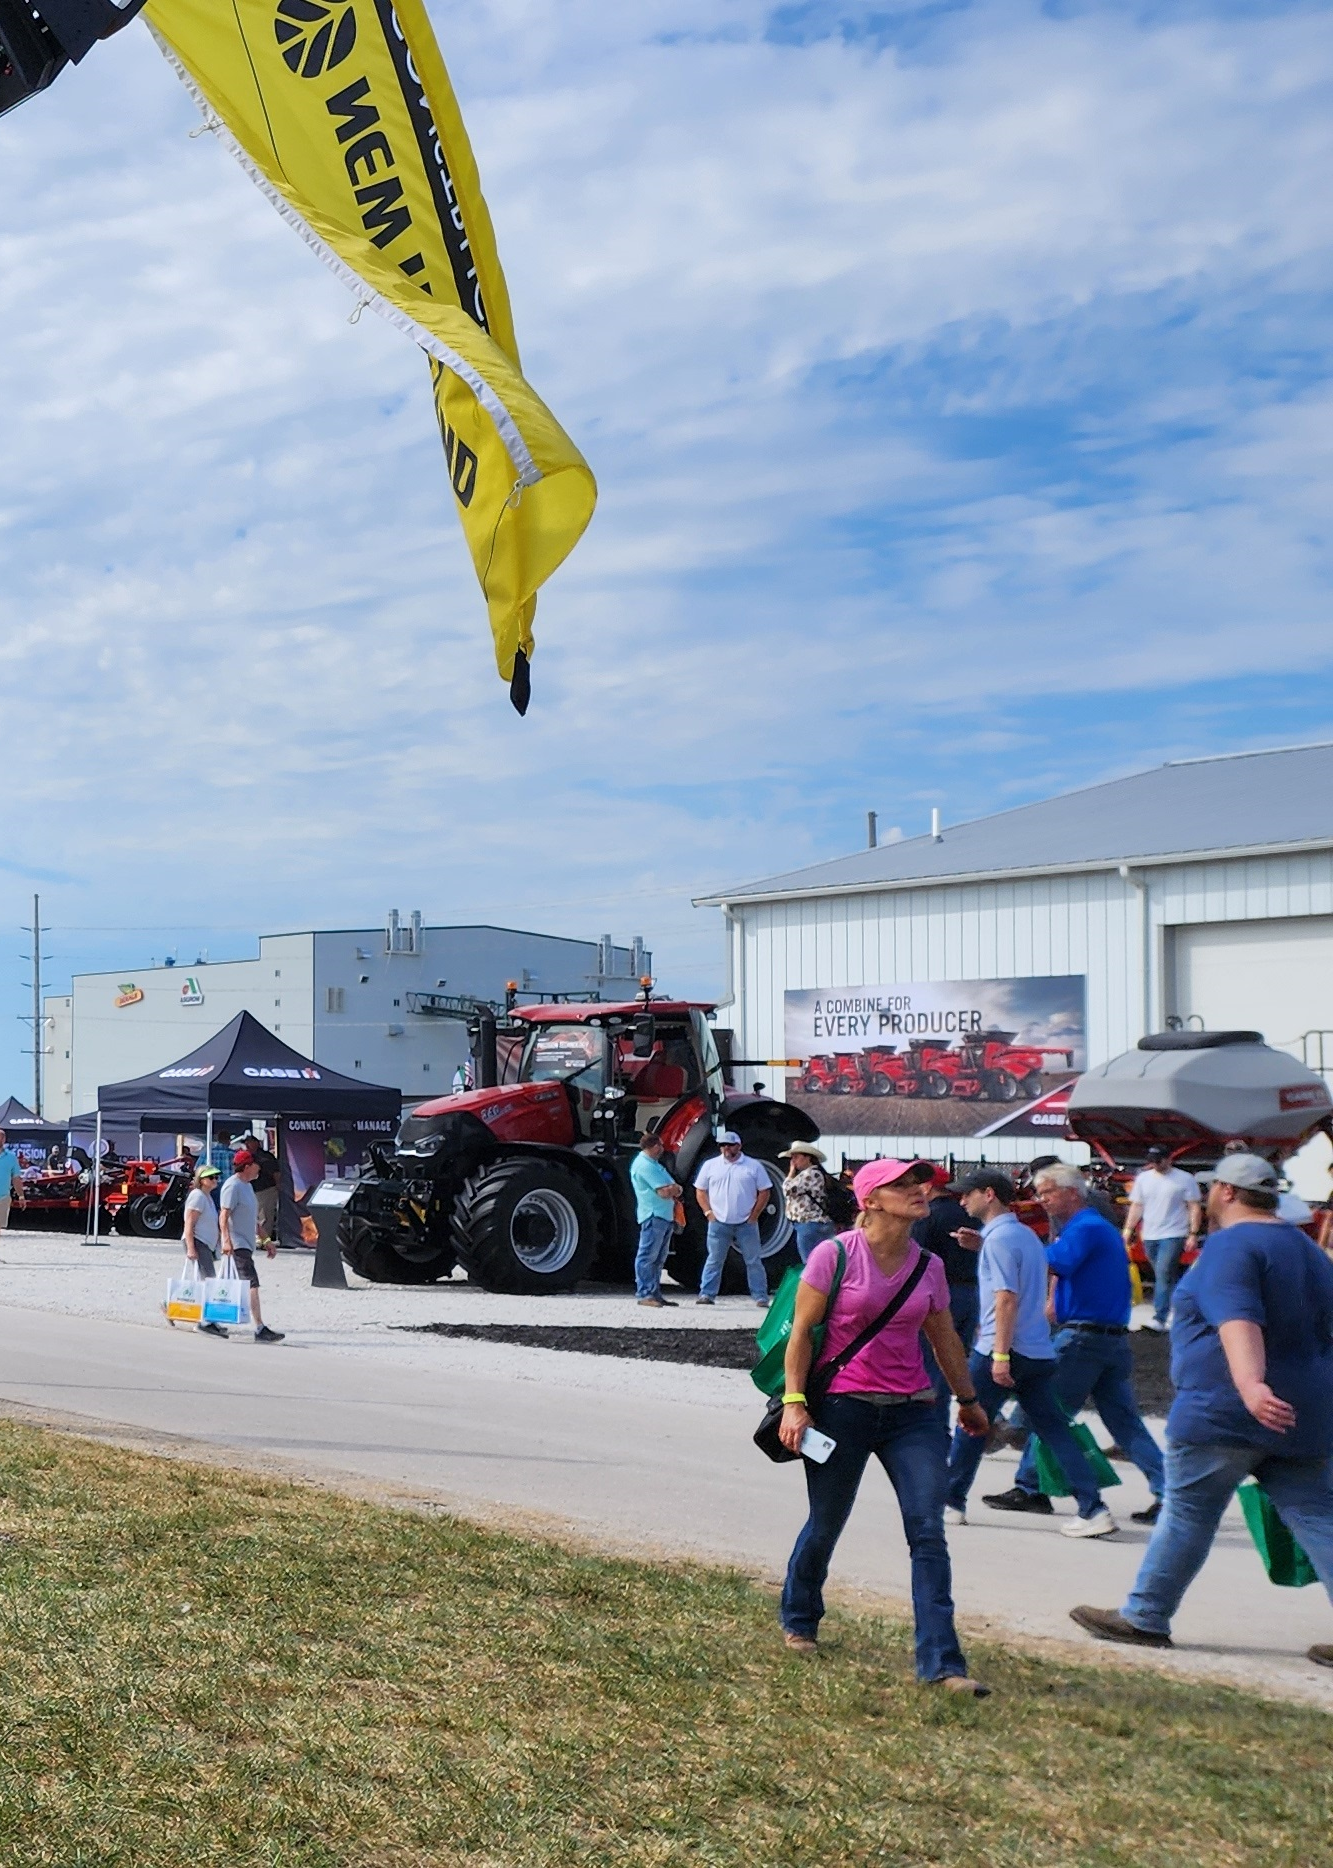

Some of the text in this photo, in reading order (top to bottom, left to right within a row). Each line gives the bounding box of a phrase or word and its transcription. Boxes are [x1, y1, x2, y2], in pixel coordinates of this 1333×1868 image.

[814, 996, 911, 1015] A COMBINE FOR
[814, 1010, 983, 1037] EVERY PRODUCER
[243, 1067, 301, 1079] CASE
[1031, 1113, 1066, 1125] CASE
[289, 1120, 326, 1131] CONNECT
[356, 1120, 392, 1132] MANAGE
